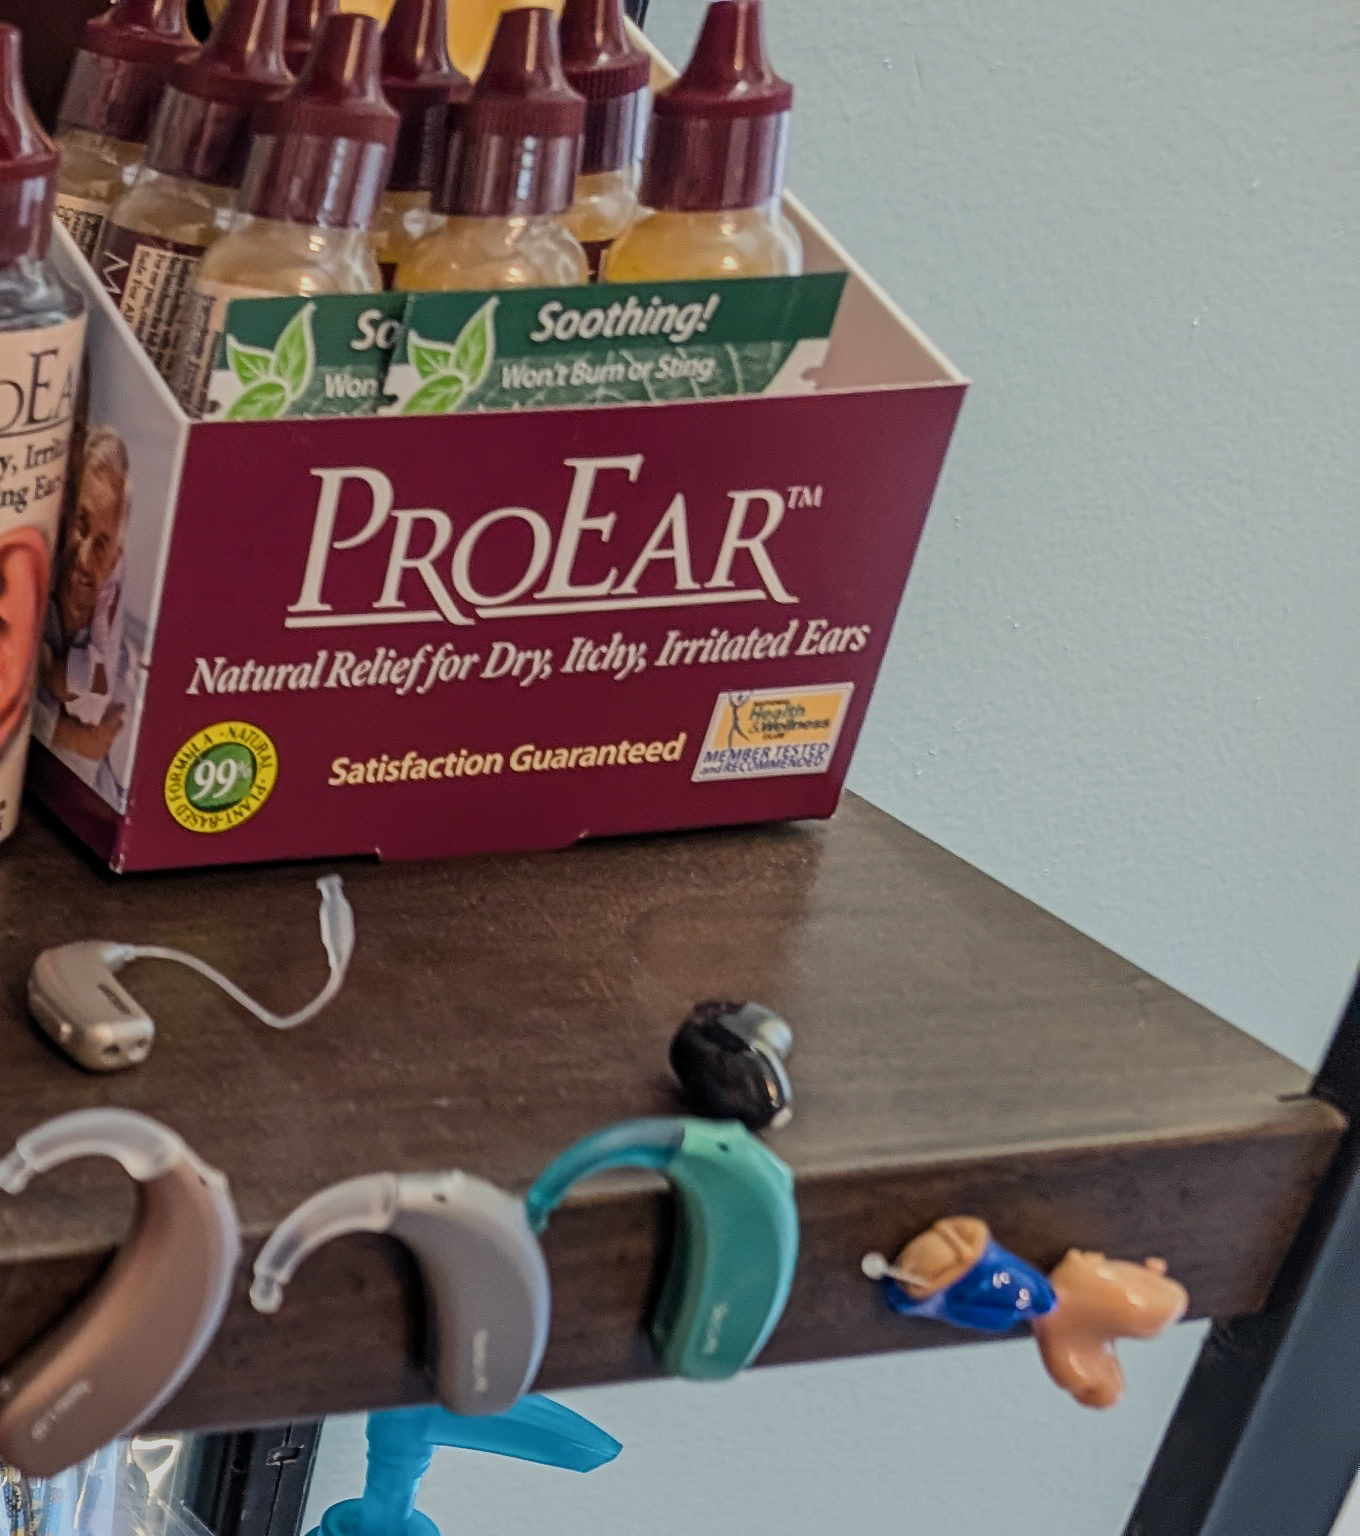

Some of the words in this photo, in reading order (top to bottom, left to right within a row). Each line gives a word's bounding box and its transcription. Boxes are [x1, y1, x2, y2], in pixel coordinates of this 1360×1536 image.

[532, 295, 719, 344] Soothing!
[502, 363, 569, 391] Won't
[571, 357, 624, 385] Burn
[629, 360, 654, 382] or
[658, 354, 716, 384] Sting
[186, 650, 328, 696] Natural
[324, 643, 434, 695] Relief
[416, 642, 480, 695] for
[481, 640, 553, 687] Dry,
[561, 632, 648, 679] Itchy,
[656, 623, 791, 671] Irritated
[795, 618, 872, 656] Ears
[328, 746, 503, 787] Satisfaction
[509, 733, 687, 774] Guaranteed
